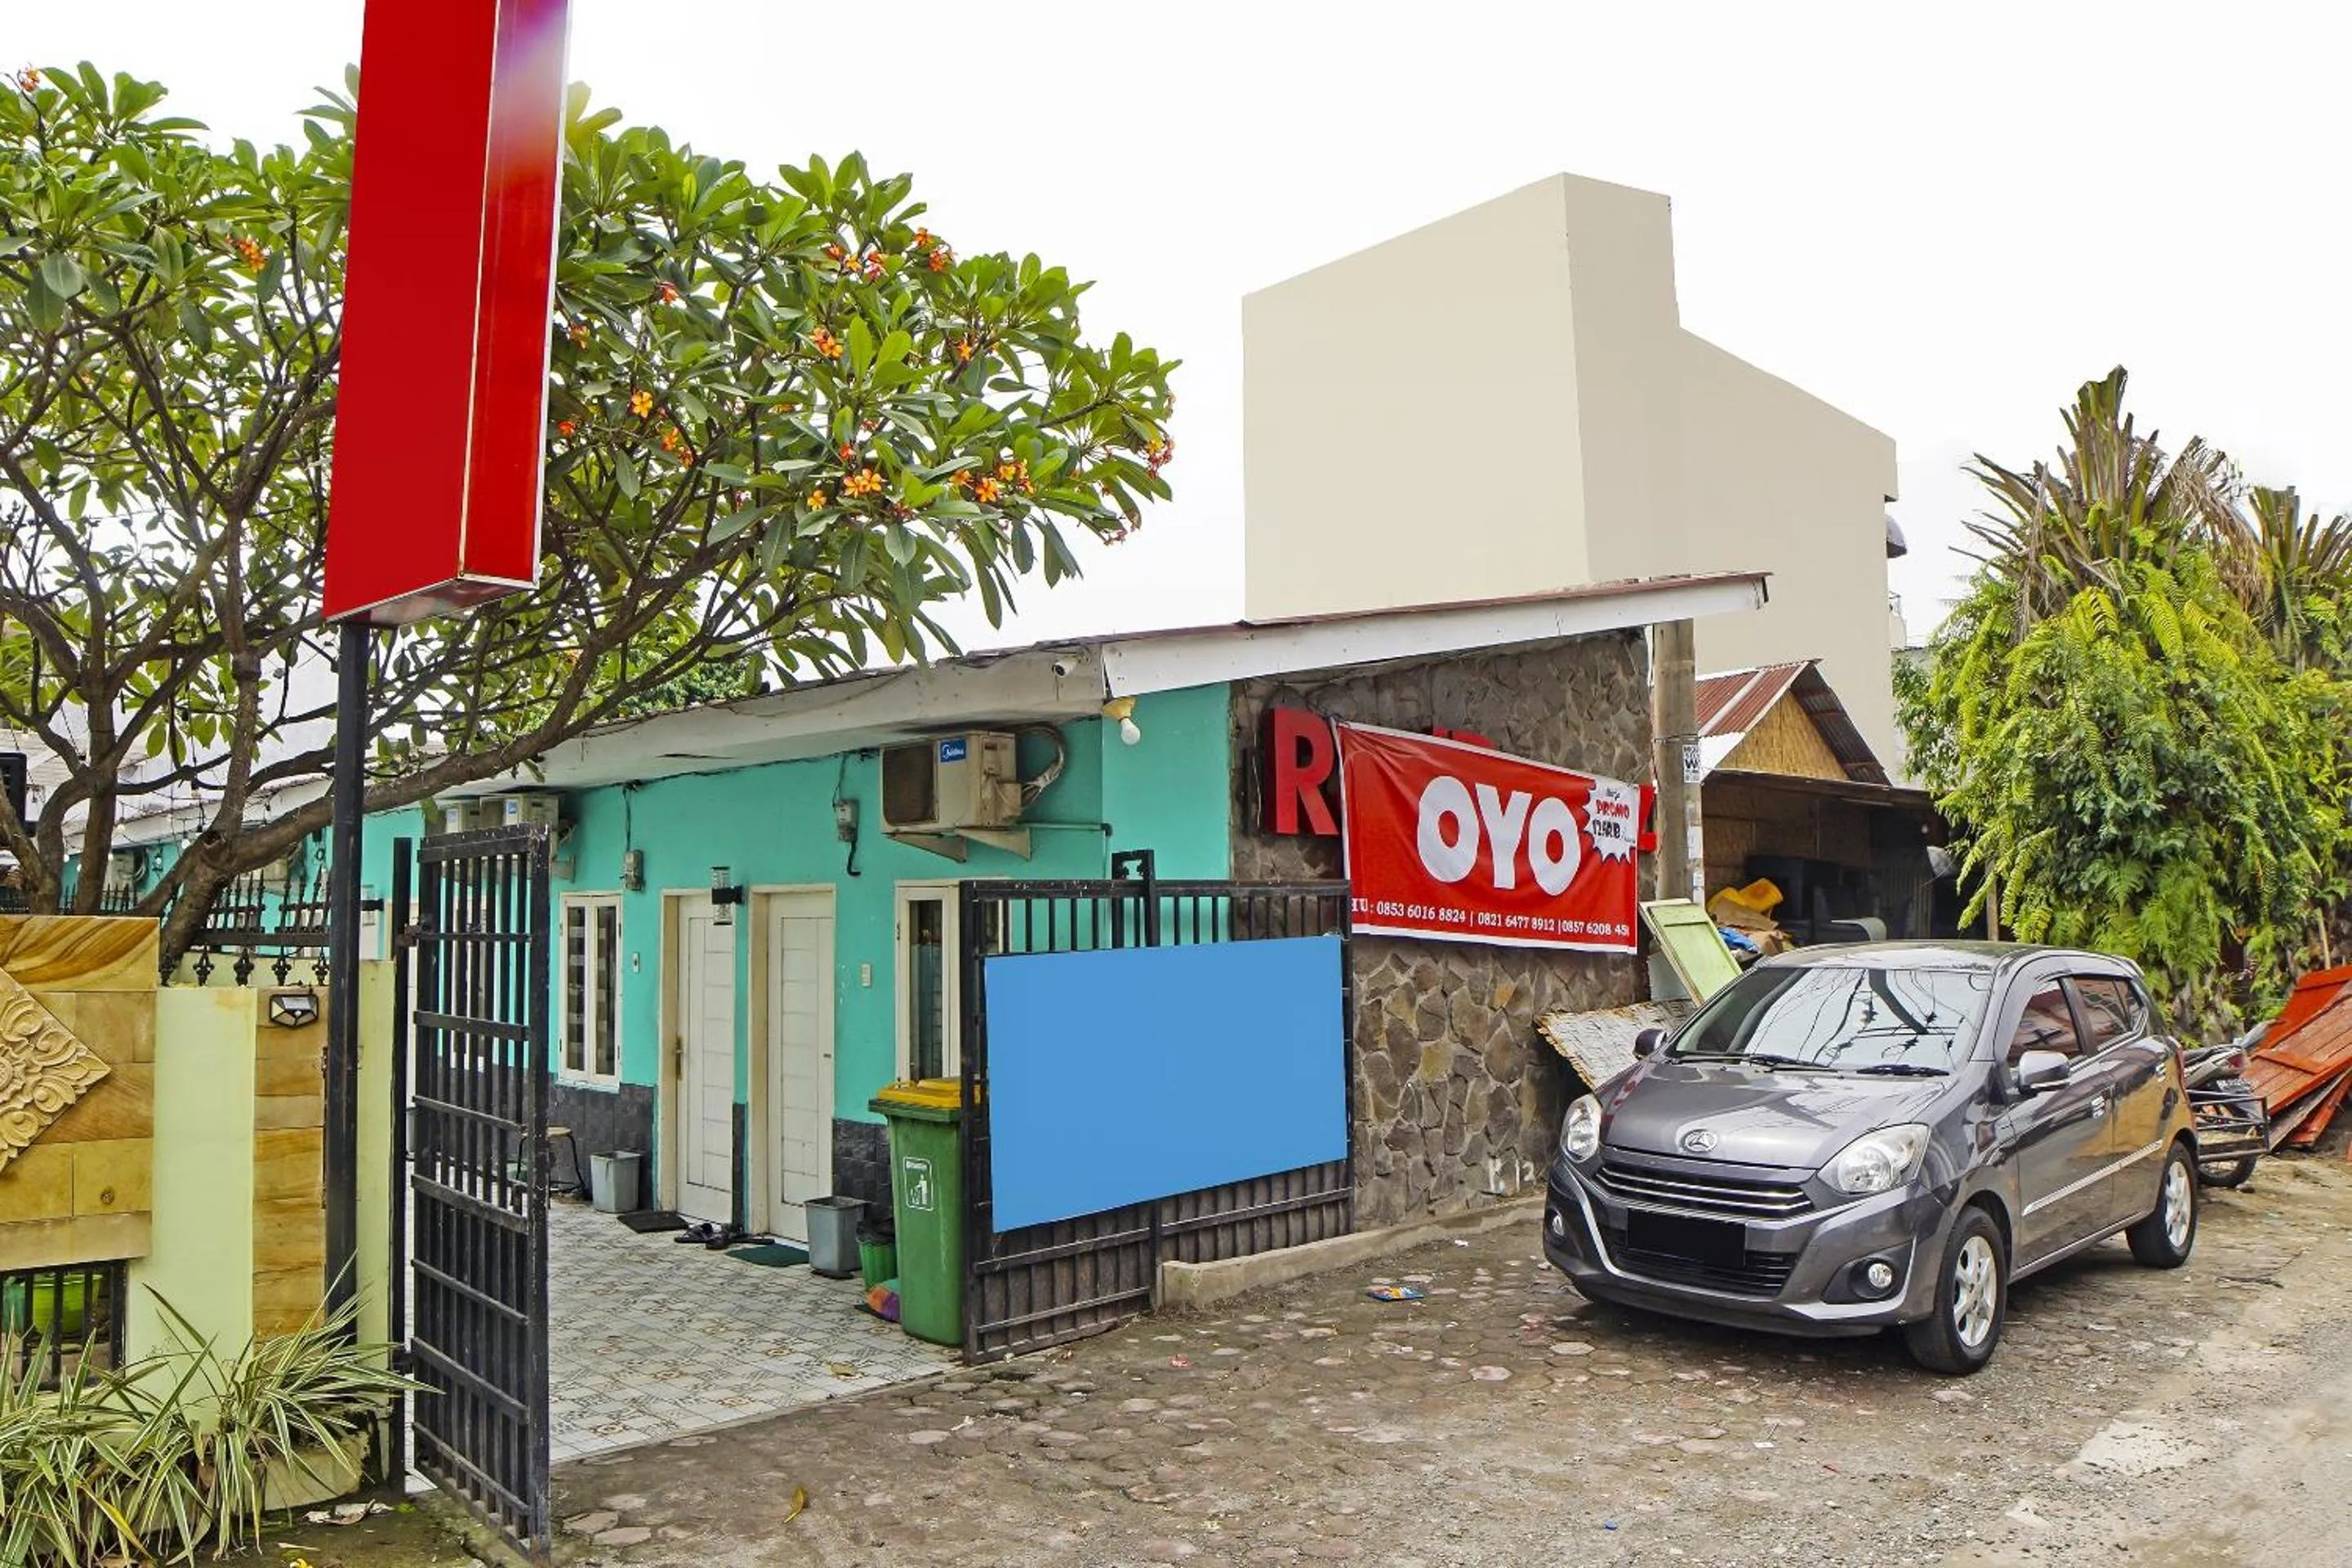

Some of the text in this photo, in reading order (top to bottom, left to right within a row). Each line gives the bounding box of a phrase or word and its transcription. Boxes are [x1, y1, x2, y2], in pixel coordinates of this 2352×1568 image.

[1417, 776, 1582, 896] OYO
[1377, 901, 1404, 916] 0853
[1407, 904, 1435, 920] 6016
[1439, 907, 1466, 923] 8824
[1477, 912, 1502, 927] 0821
[1505, 915, 1529, 929] 6477
[1531, 919, 1555, 932] 8912
[1587, 923, 1611, 935] 6208
